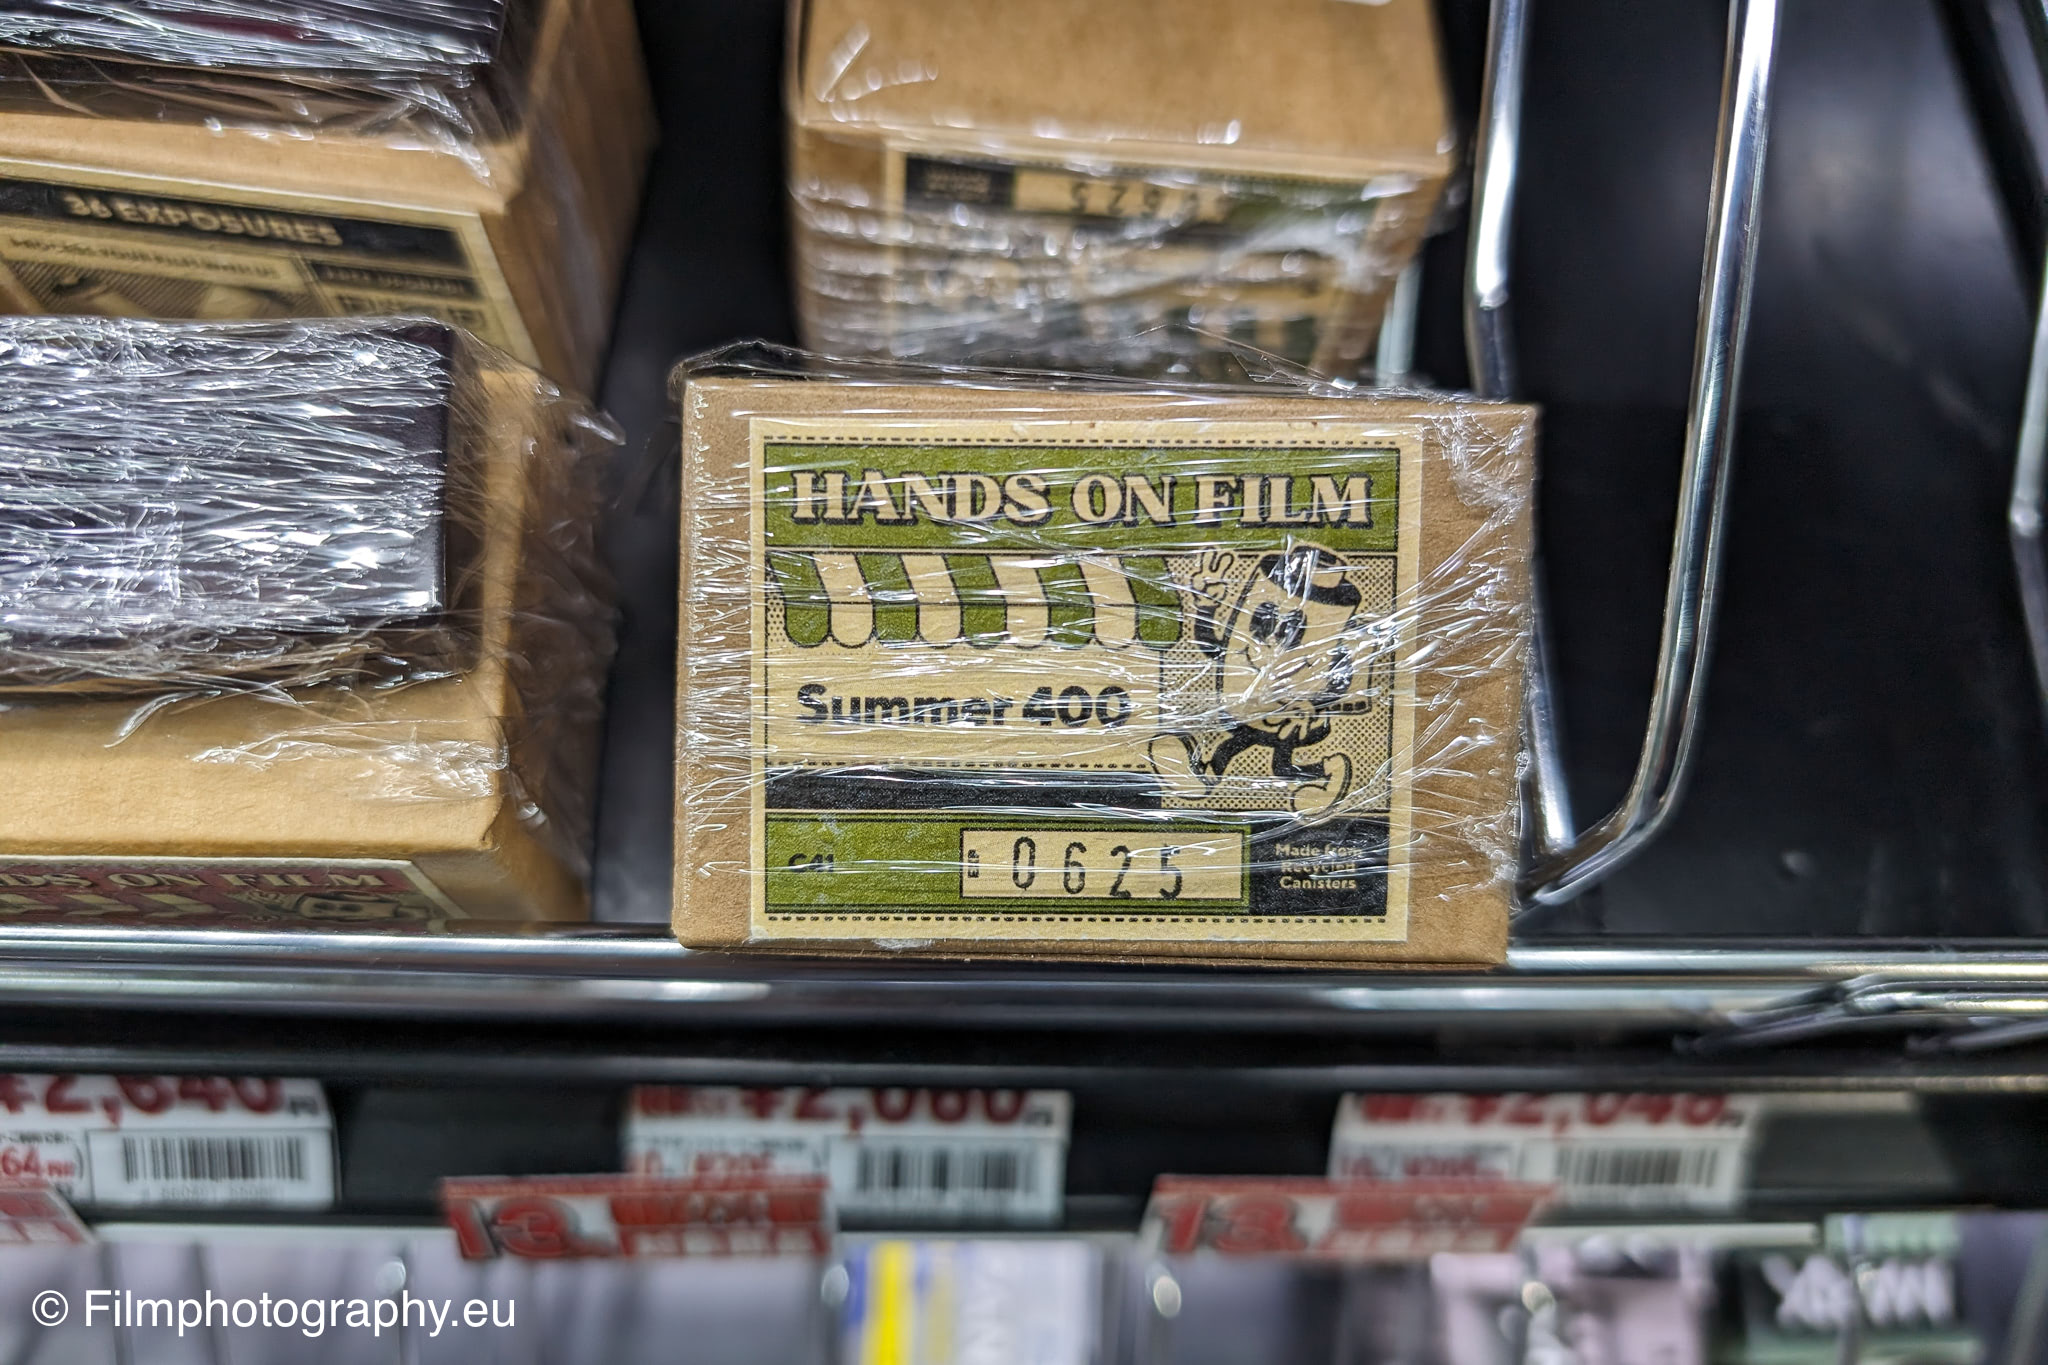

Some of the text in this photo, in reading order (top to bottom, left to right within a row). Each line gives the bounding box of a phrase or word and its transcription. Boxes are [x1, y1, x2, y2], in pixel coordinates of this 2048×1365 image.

[114, 201, 343, 247] EXPOSURES
[791, 469, 1374, 530] HANDS ON FILM
[797, 683, 1132, 728] Summer 400
[1275, 842, 1321, 857] Made
[788, 852, 834, 873] C41
[1012, 835, 1184, 900] 0625
[1280, 860, 1356, 876] Recycled
[107, 872, 208, 888] ON
[217, 872, 387, 888] FILM
[1280, 876, 1357, 889] Canisters
